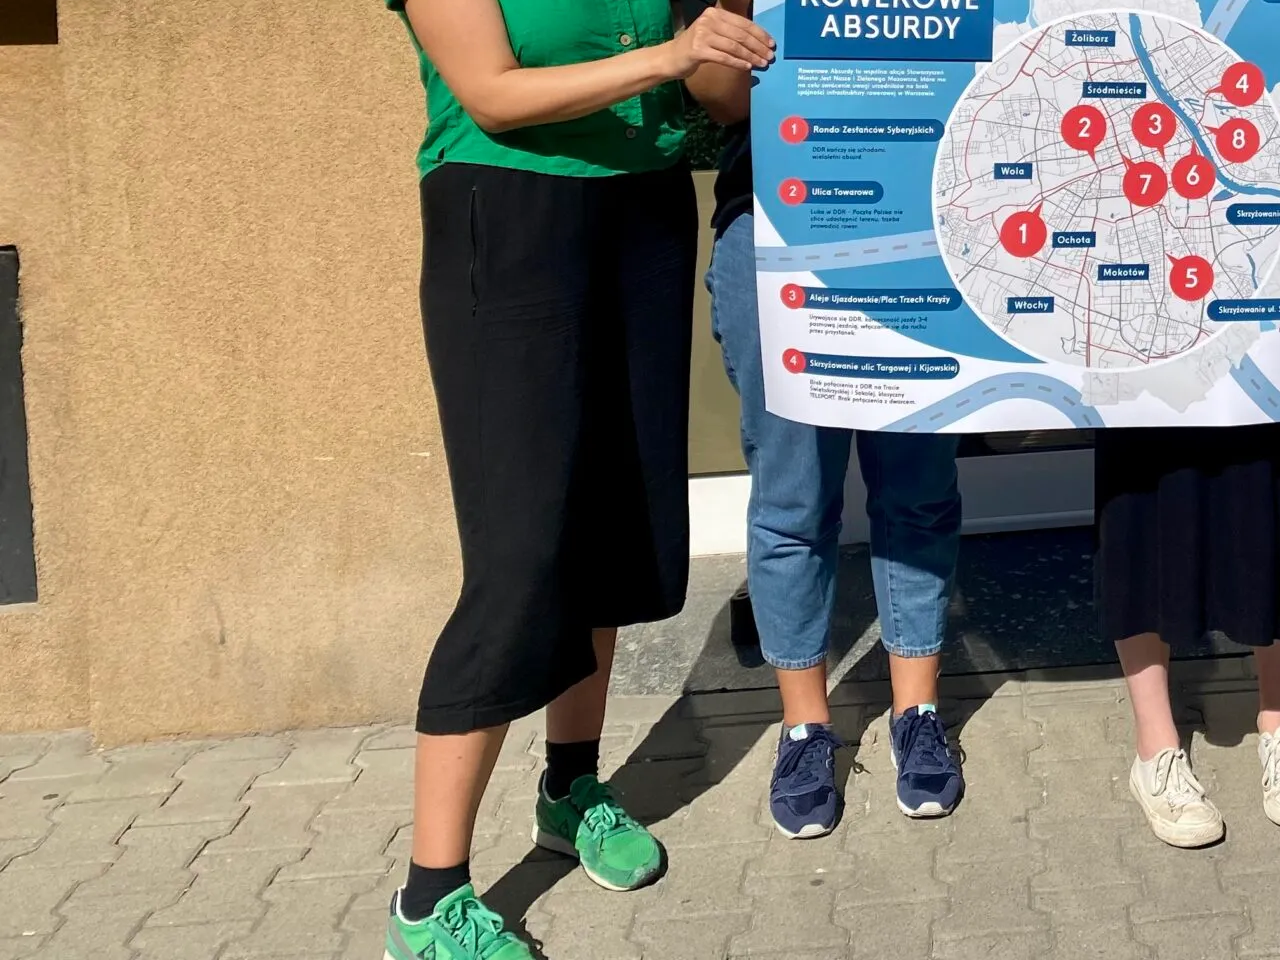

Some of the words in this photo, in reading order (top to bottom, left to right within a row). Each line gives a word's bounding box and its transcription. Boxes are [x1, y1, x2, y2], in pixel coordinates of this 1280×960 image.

[820, 14, 961, 40] ABSURDY
[1071, 33, 1109, 43] Żoliborz
[1086, 85, 1142, 96] Śródmieście
[1235, 73, 1250, 93] 4
[791, 124, 797, 135] 1
[813, 125, 840, 134] Rondo
[842, 125, 885, 134] Zesłańców
[887, 125, 935, 136] Syberyjskich
[1078, 117, 1092, 138] 2
[1149, 114, 1162, 135] 3
[1232, 128, 1246, 149] 8
[1001, 167, 1025, 176] Wola
[1186, 165, 1200, 185] 6
[789, 186, 797, 197] 2
[811, 187, 832, 196] Ulica
[833, 187, 874, 196] Towarowa
[1139, 174, 1152, 195] 7
[1018, 223, 1028, 244] 1
[1057, 235, 1091, 245] Ochota
[1103, 267, 1145, 277] Mokotów
[1184, 267, 1198, 288] 5
[789, 290, 796, 301] 3
[809, 294, 830, 303] Aleje
[831, 294, 898, 305] Ujazdowskie/Plac
[899, 295, 924, 304] Trzech
[926, 295, 951, 305] Krzyży
[1014, 300, 1049, 311] Włochy
[1218, 306, 1266, 316] Skrzyżowanie
[1268, 304, 1277, 313] ul.
[789, 355, 797, 366] 4
[809, 359, 859, 371] Skrzyżowanie
[860, 363, 875, 371] ulic
[876, 363, 912, 373] Targowej
[919, 363, 958, 373] Kijowskiej
